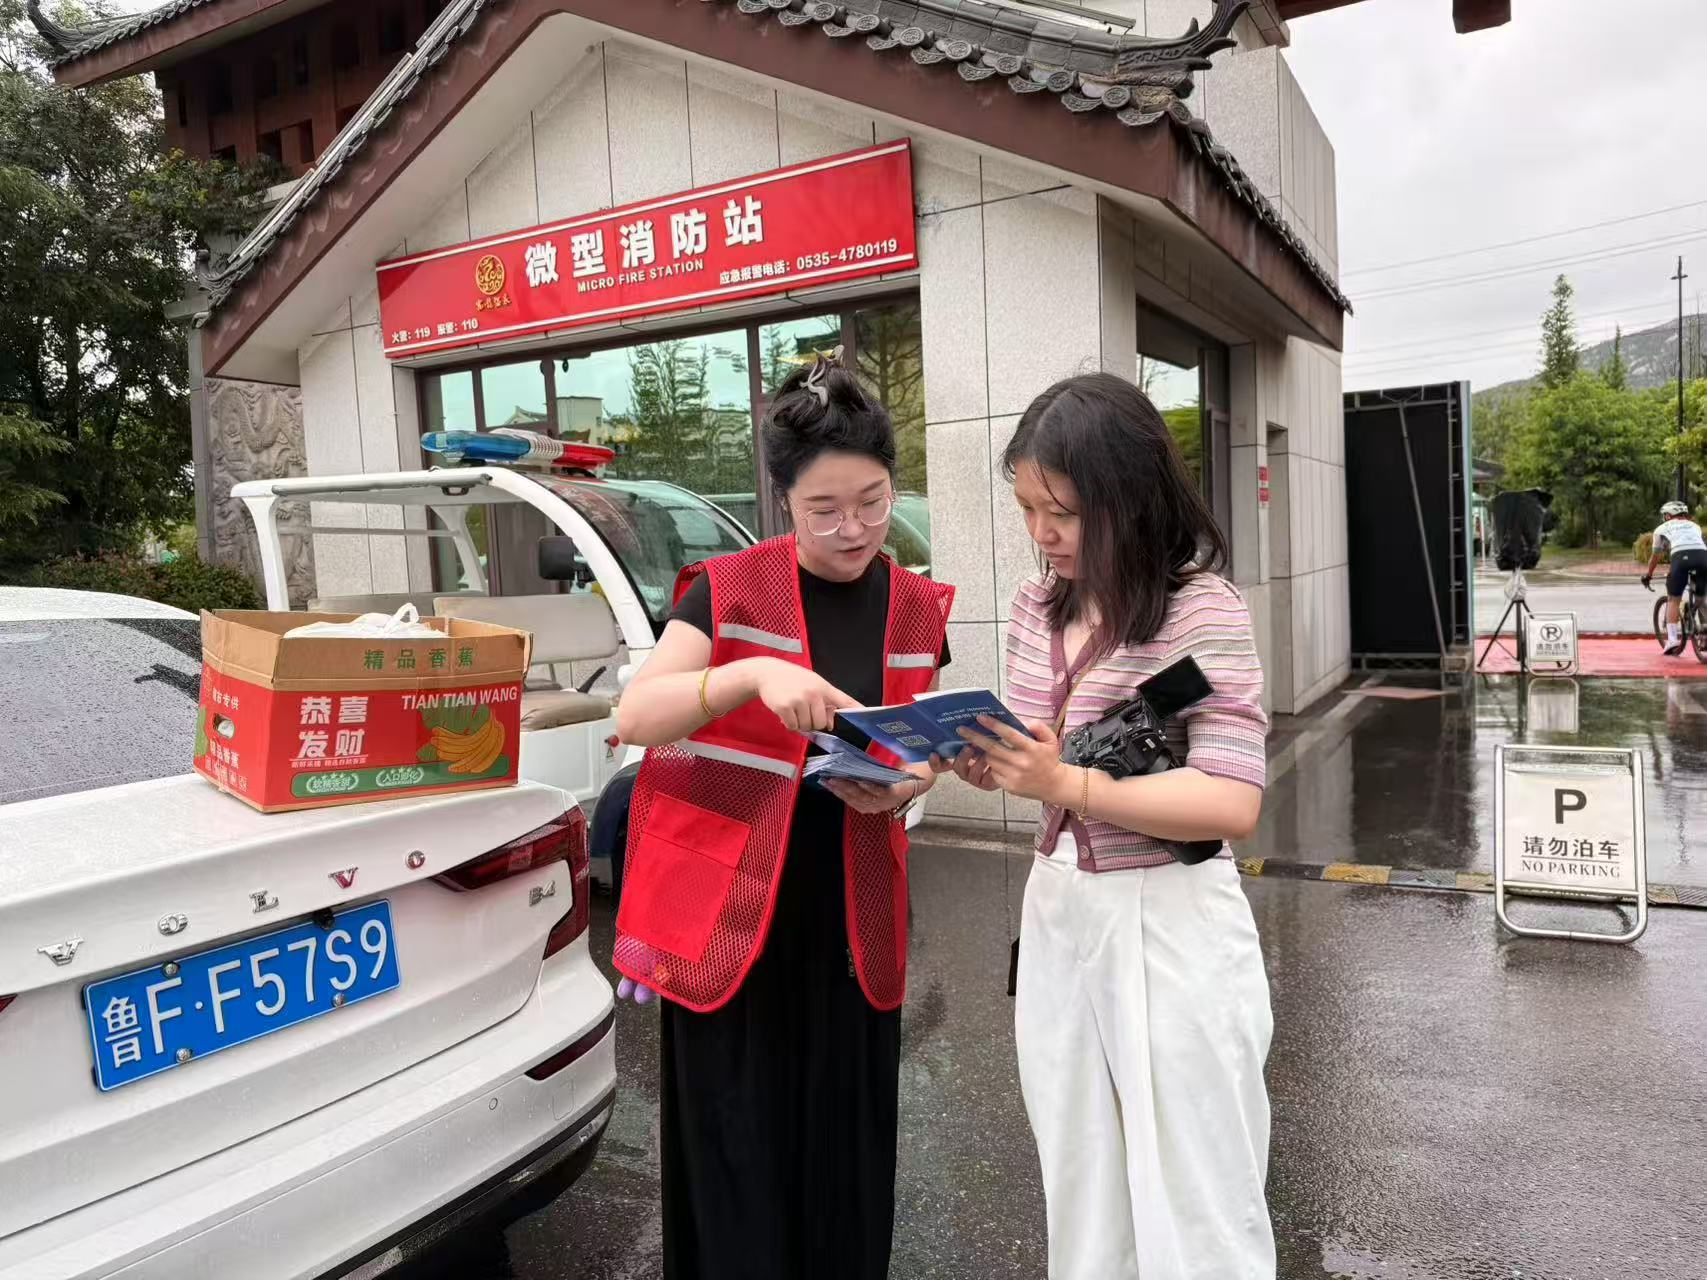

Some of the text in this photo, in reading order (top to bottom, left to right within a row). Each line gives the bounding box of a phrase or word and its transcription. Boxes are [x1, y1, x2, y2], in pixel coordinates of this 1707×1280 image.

[525, 196, 763, 287] 微型消防站
[577, 259, 704, 292] MICRO FIRE STATION
[364, 647, 475, 671] 精品香蕉
[300, 696, 369, 724] 恭喜
[402, 686, 518, 710] TIAN TIAN WANG
[298, 731, 366, 758] 发财
[1554, 788, 1587, 824] P
[1523, 836, 1620, 860] 请勿泊车
[1522, 860, 1620, 878] NO PARKING
[38, 848, 427, 966] VOLVO
